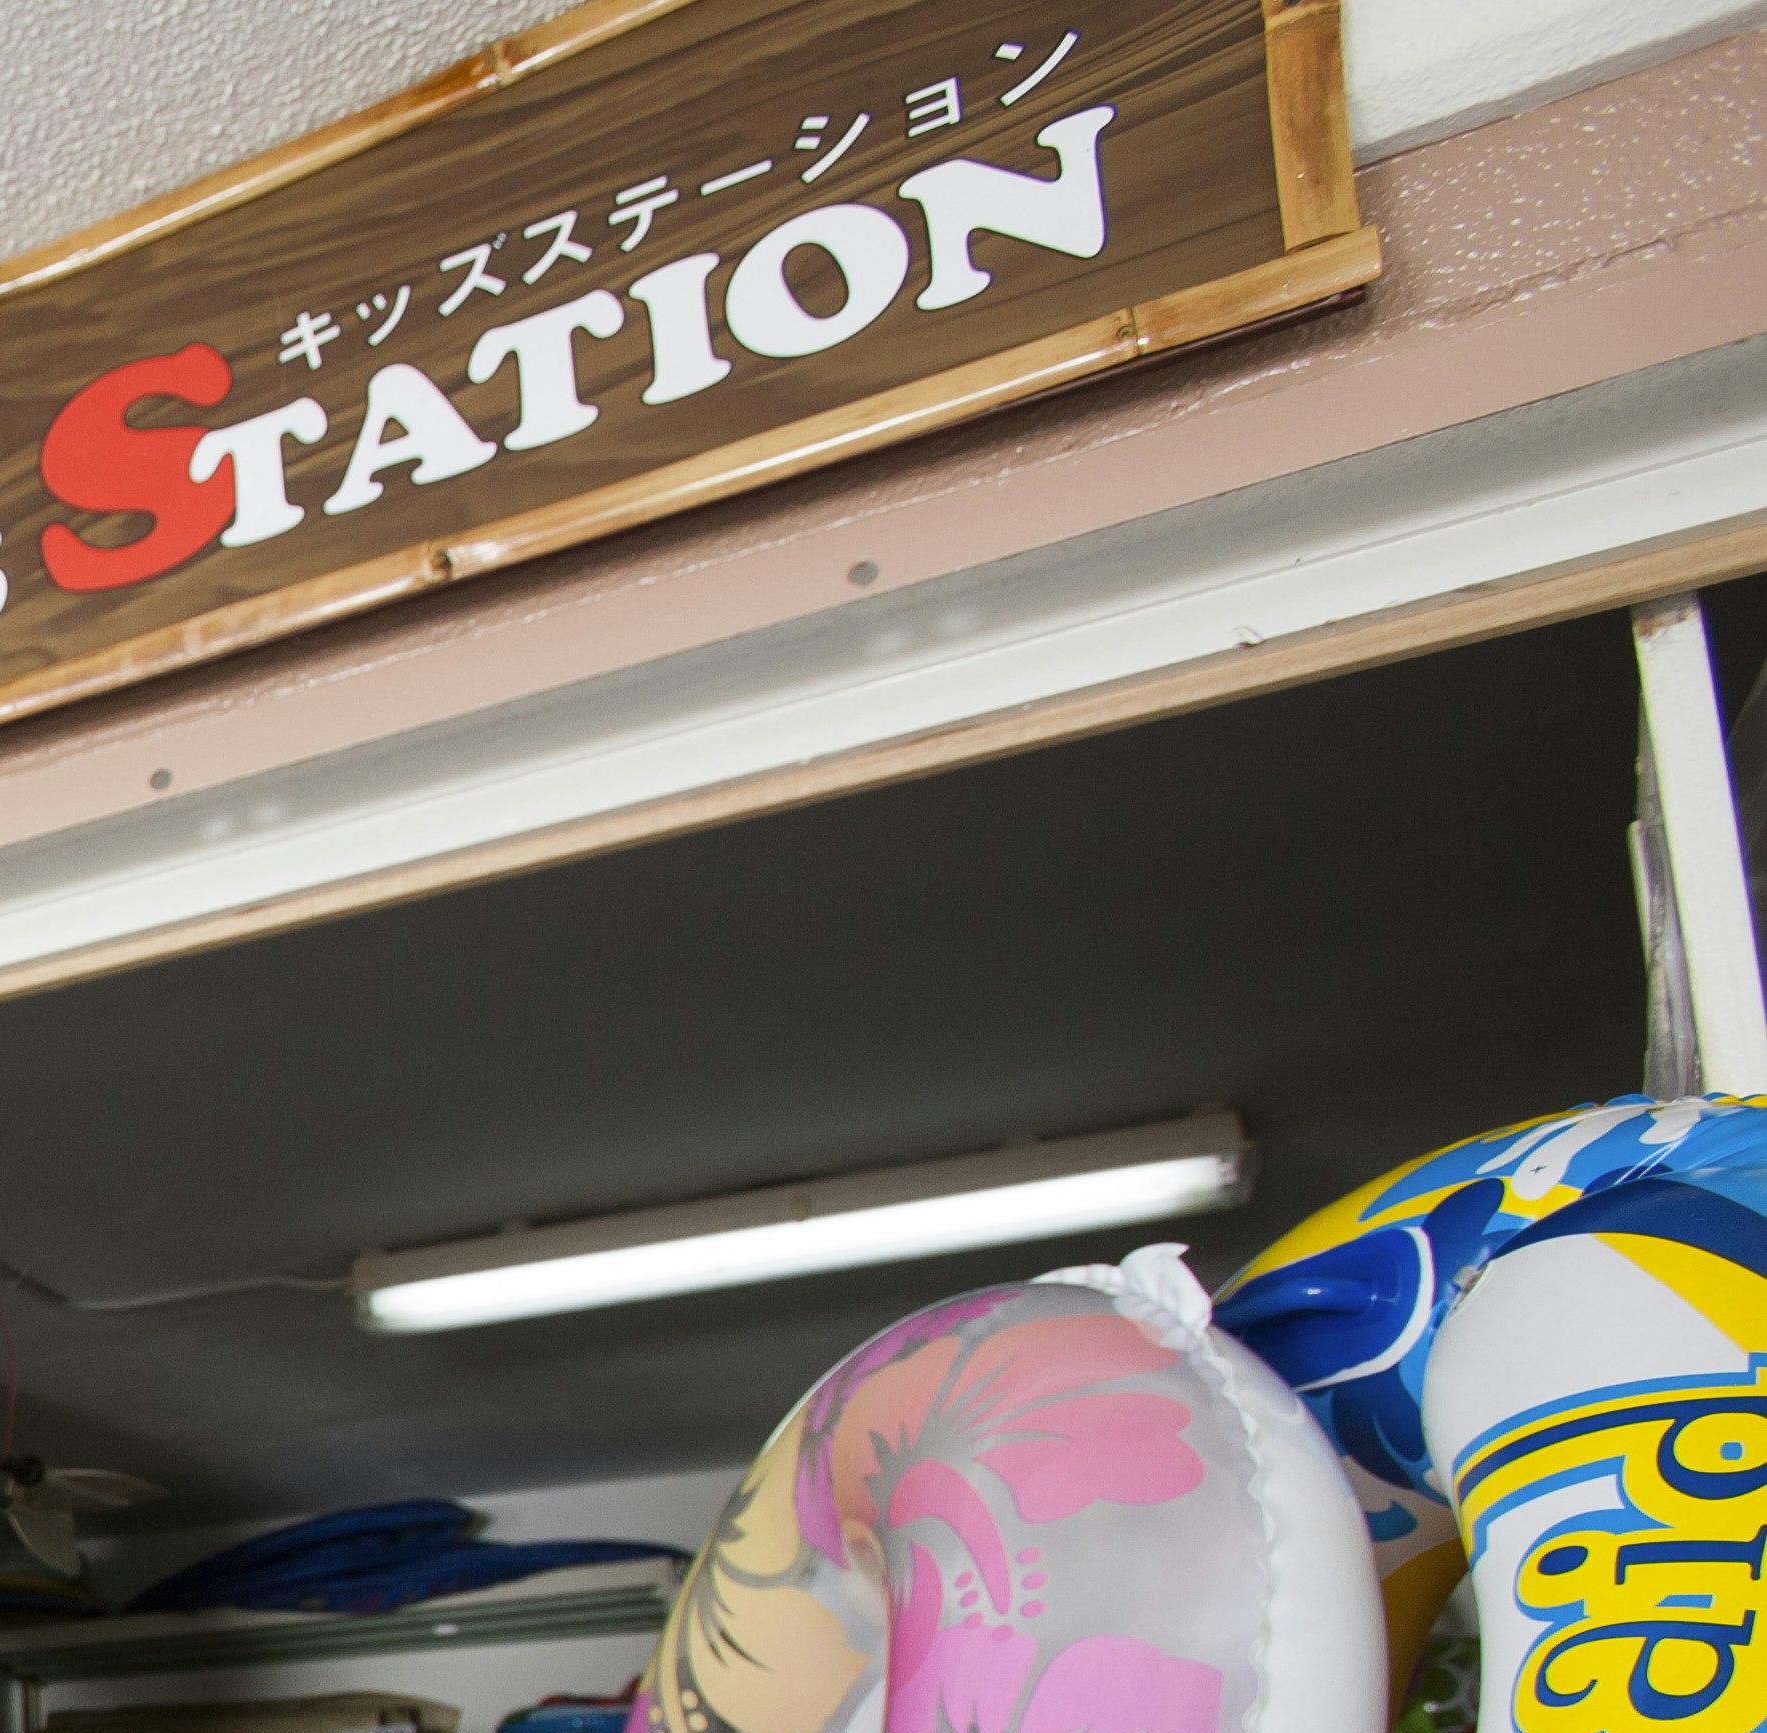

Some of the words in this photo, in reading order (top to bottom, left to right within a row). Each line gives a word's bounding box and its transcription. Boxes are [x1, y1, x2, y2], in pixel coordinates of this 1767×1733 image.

[41, 104, 1118, 592] STATION
[278, 32, 1079, 369] キッズステーション
